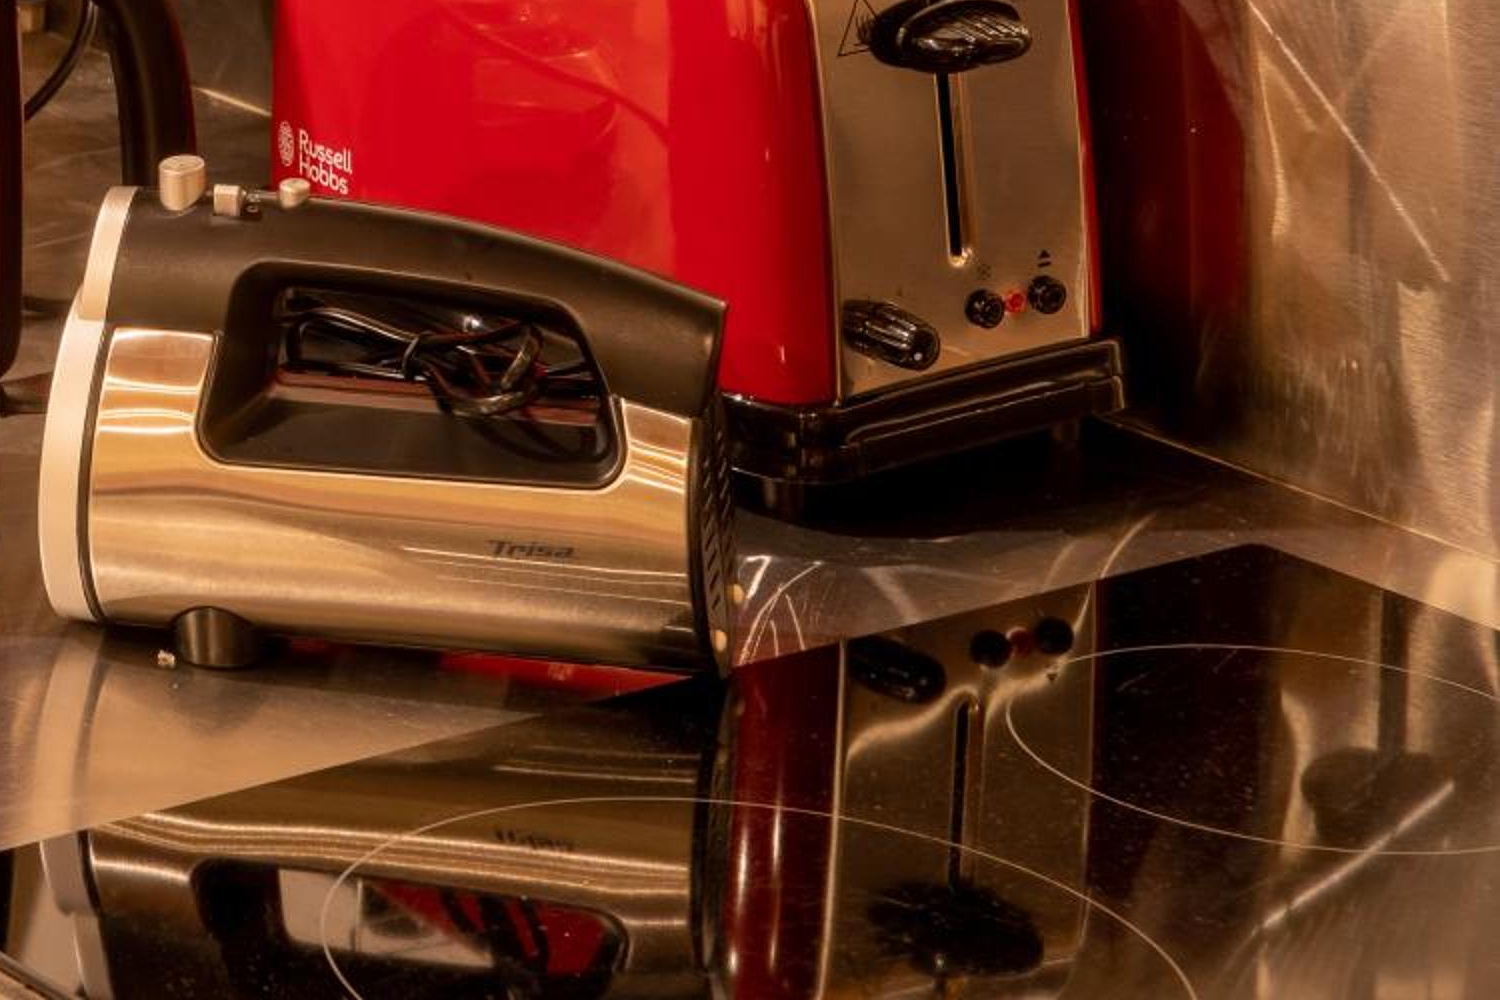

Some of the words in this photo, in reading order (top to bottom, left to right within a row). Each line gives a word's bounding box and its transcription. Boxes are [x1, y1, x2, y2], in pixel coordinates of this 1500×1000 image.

[299, 128, 353, 174] Russell
[299, 151, 349, 195] Hobbs
[485, 539, 576, 559] Trisa
